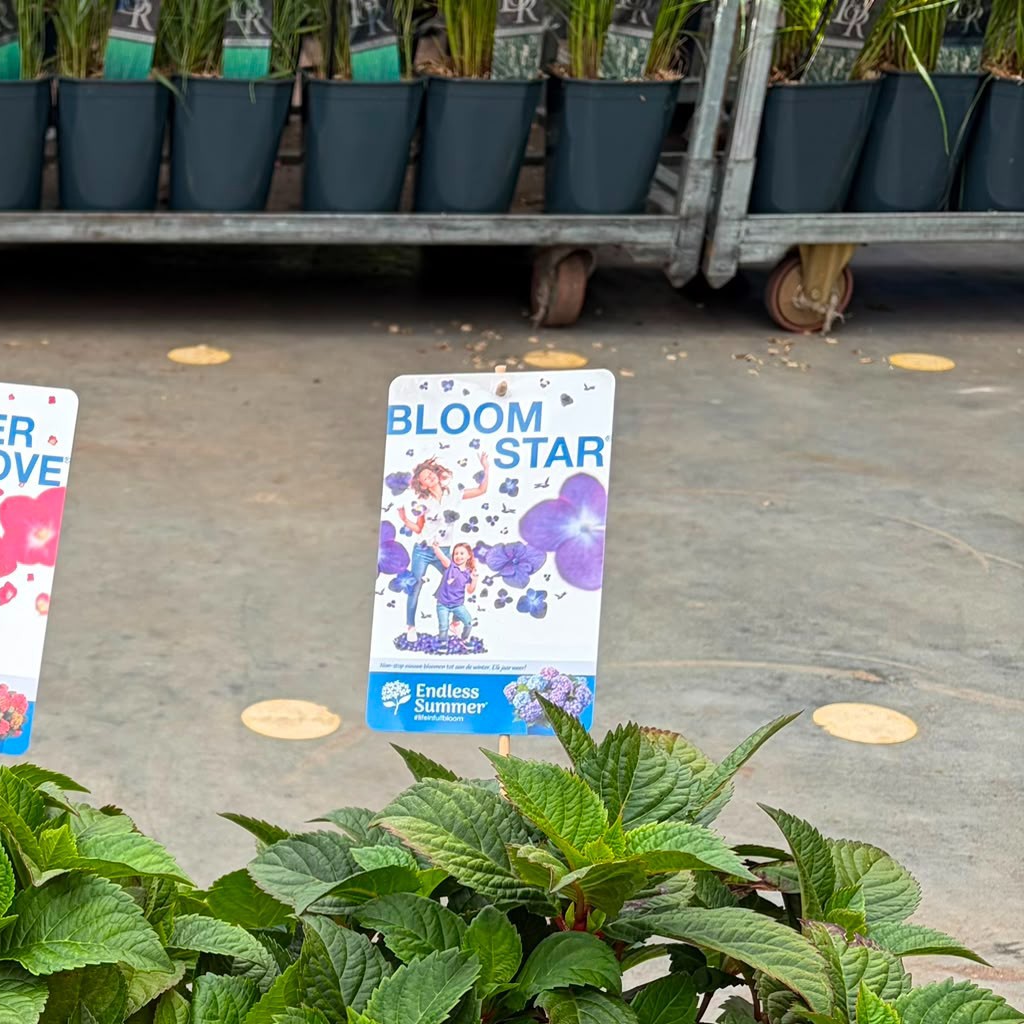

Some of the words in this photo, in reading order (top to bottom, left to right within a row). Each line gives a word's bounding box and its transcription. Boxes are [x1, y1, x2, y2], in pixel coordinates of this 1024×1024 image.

[386, 401, 543, 435] BLOOM
[493, 436, 605, 469] STAR
[416, 683, 480, 699] Endless
[414, 698, 487, 714] Summer
